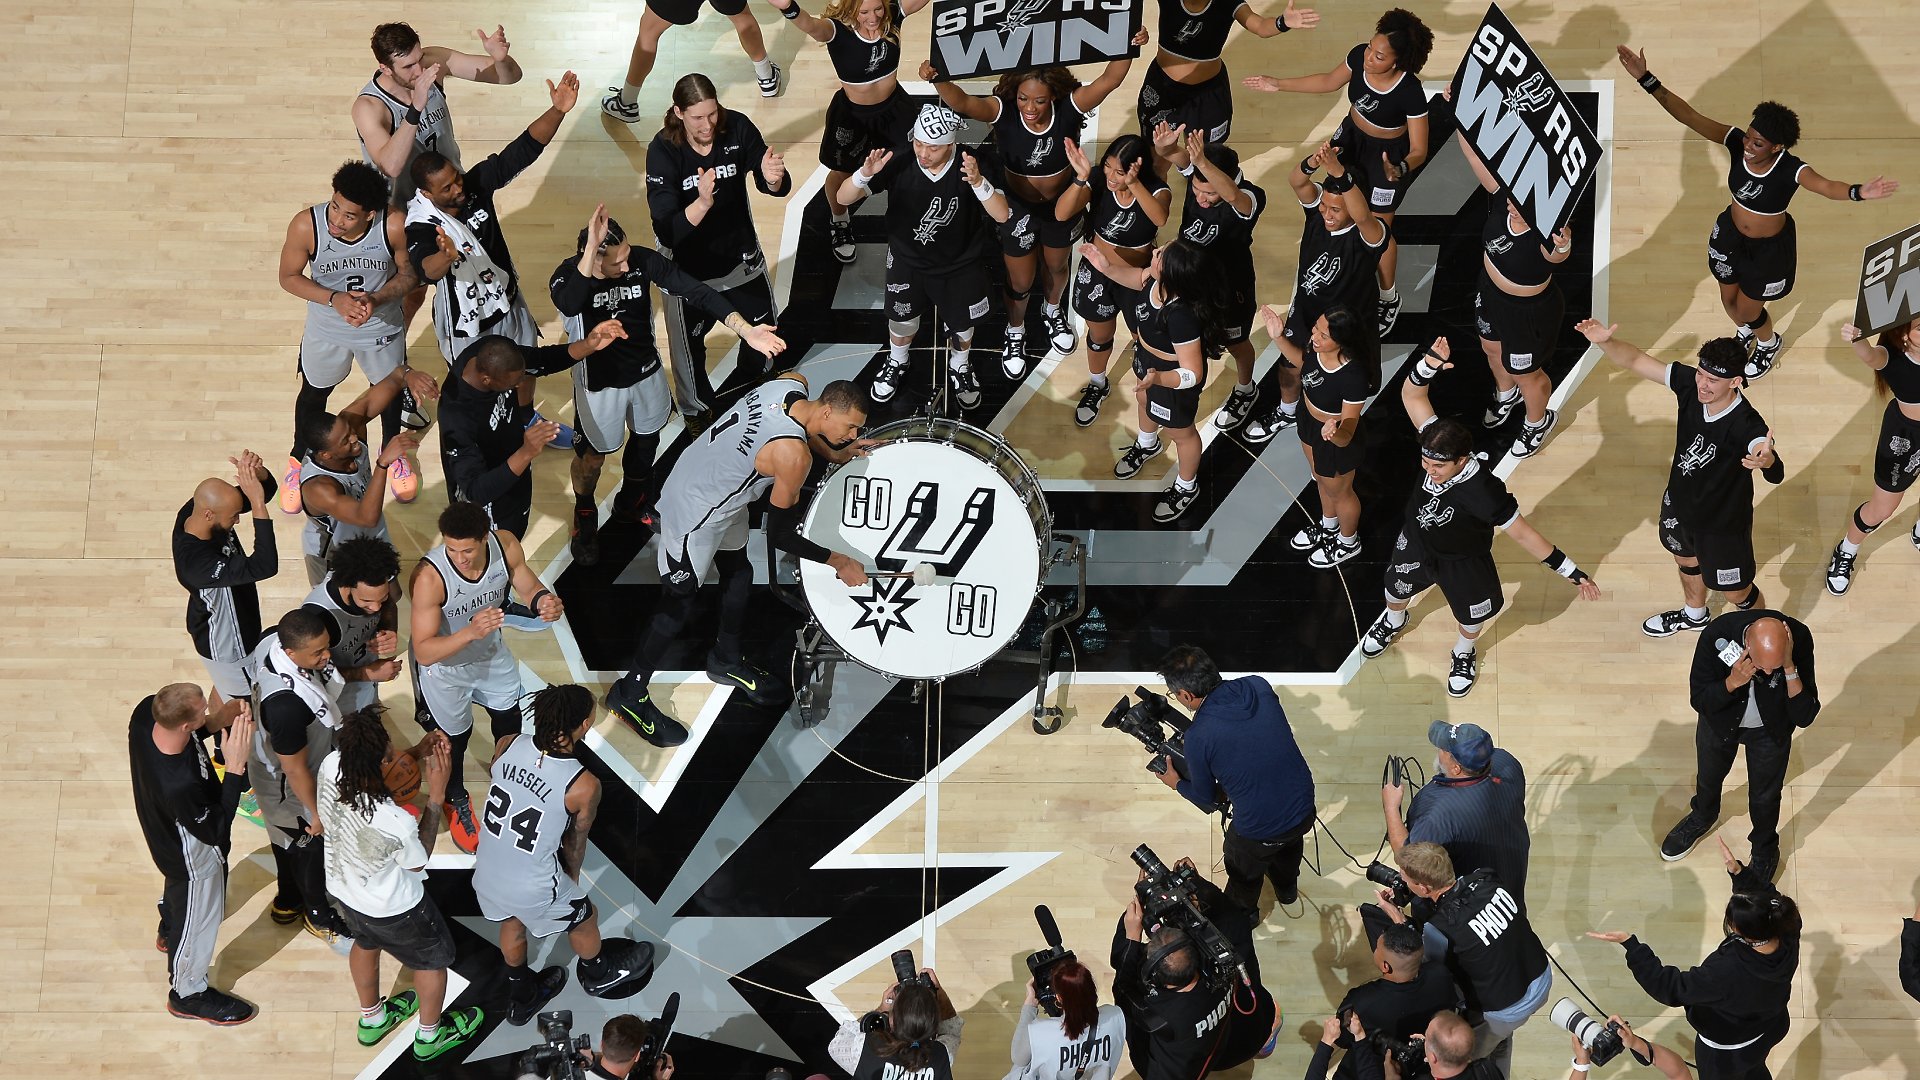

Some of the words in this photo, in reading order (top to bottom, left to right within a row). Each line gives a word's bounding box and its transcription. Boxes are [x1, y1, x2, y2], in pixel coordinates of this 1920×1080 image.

[936, 11, 1130, 76] WIN
[424, 132, 438, 152] 7
[1454, 53, 1572, 240] WIN
[682, 163, 737, 191] SPRS
[320, 260, 339, 275] SAN
[342, 257, 388, 271] ANTONIO
[345, 275, 366, 293] 2
[708, 410, 741, 446] 1
[842, 475, 892, 530] GO
[447, 603, 468, 618] SAN
[470, 588, 505, 610] ANTONI
[947, 582, 997, 638] GO
[341, 634, 359, 652] SAN
[353, 642, 367, 665] 3
[502, 762, 552, 804] VASSELL
[482, 783, 545, 855] 24
[1467, 887, 1518, 947] PHOTO
